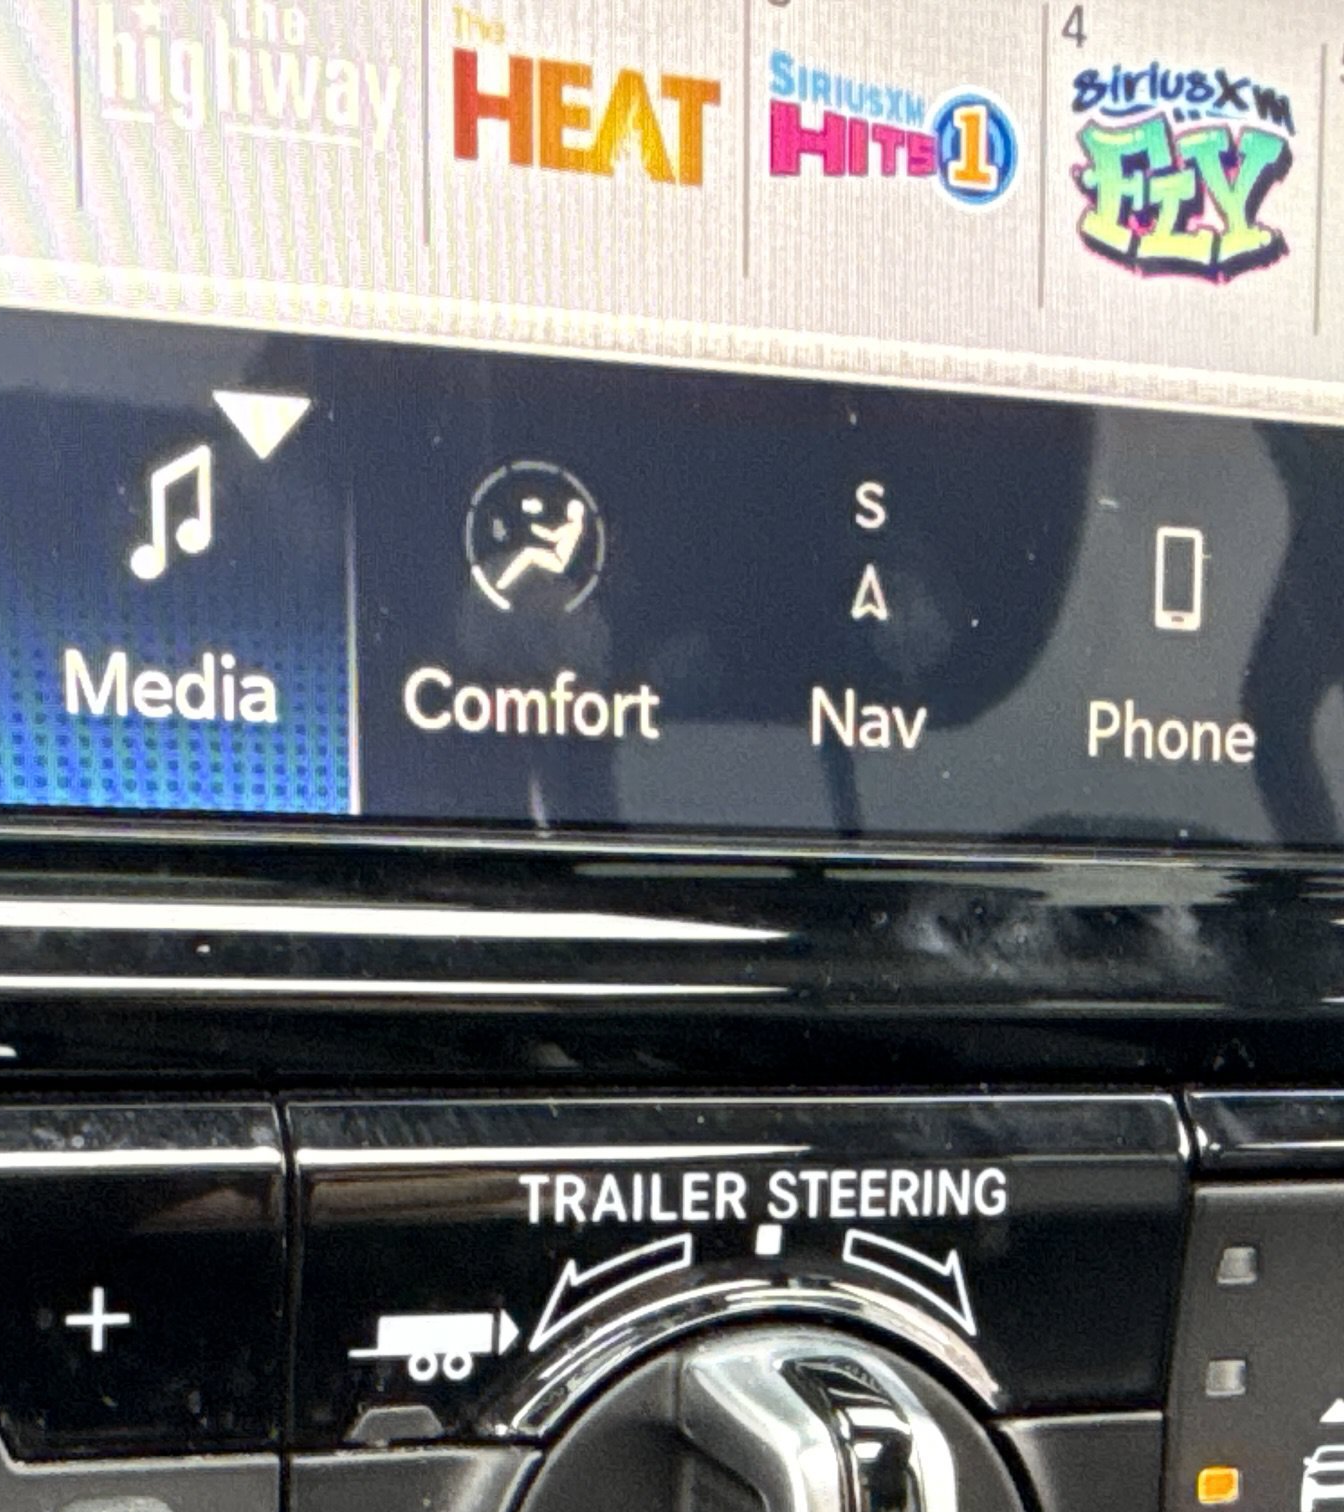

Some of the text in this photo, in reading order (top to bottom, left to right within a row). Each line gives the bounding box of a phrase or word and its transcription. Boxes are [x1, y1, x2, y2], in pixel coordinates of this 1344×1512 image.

[1061, 4, 1088, 48] 4
[96, 2, 402, 152] highway
[453, 48, 722, 188] HEAT
[947, 104, 1000, 190] 1
[855, 481, 887, 530] S
[63, 649, 279, 724] Media
[403, 667, 660, 741] Comfort
[810, 686, 928, 750] Nav
[1087, 699, 1257, 764] Phone
[518, 1167, 1008, 1224] TRAILER STEERING
